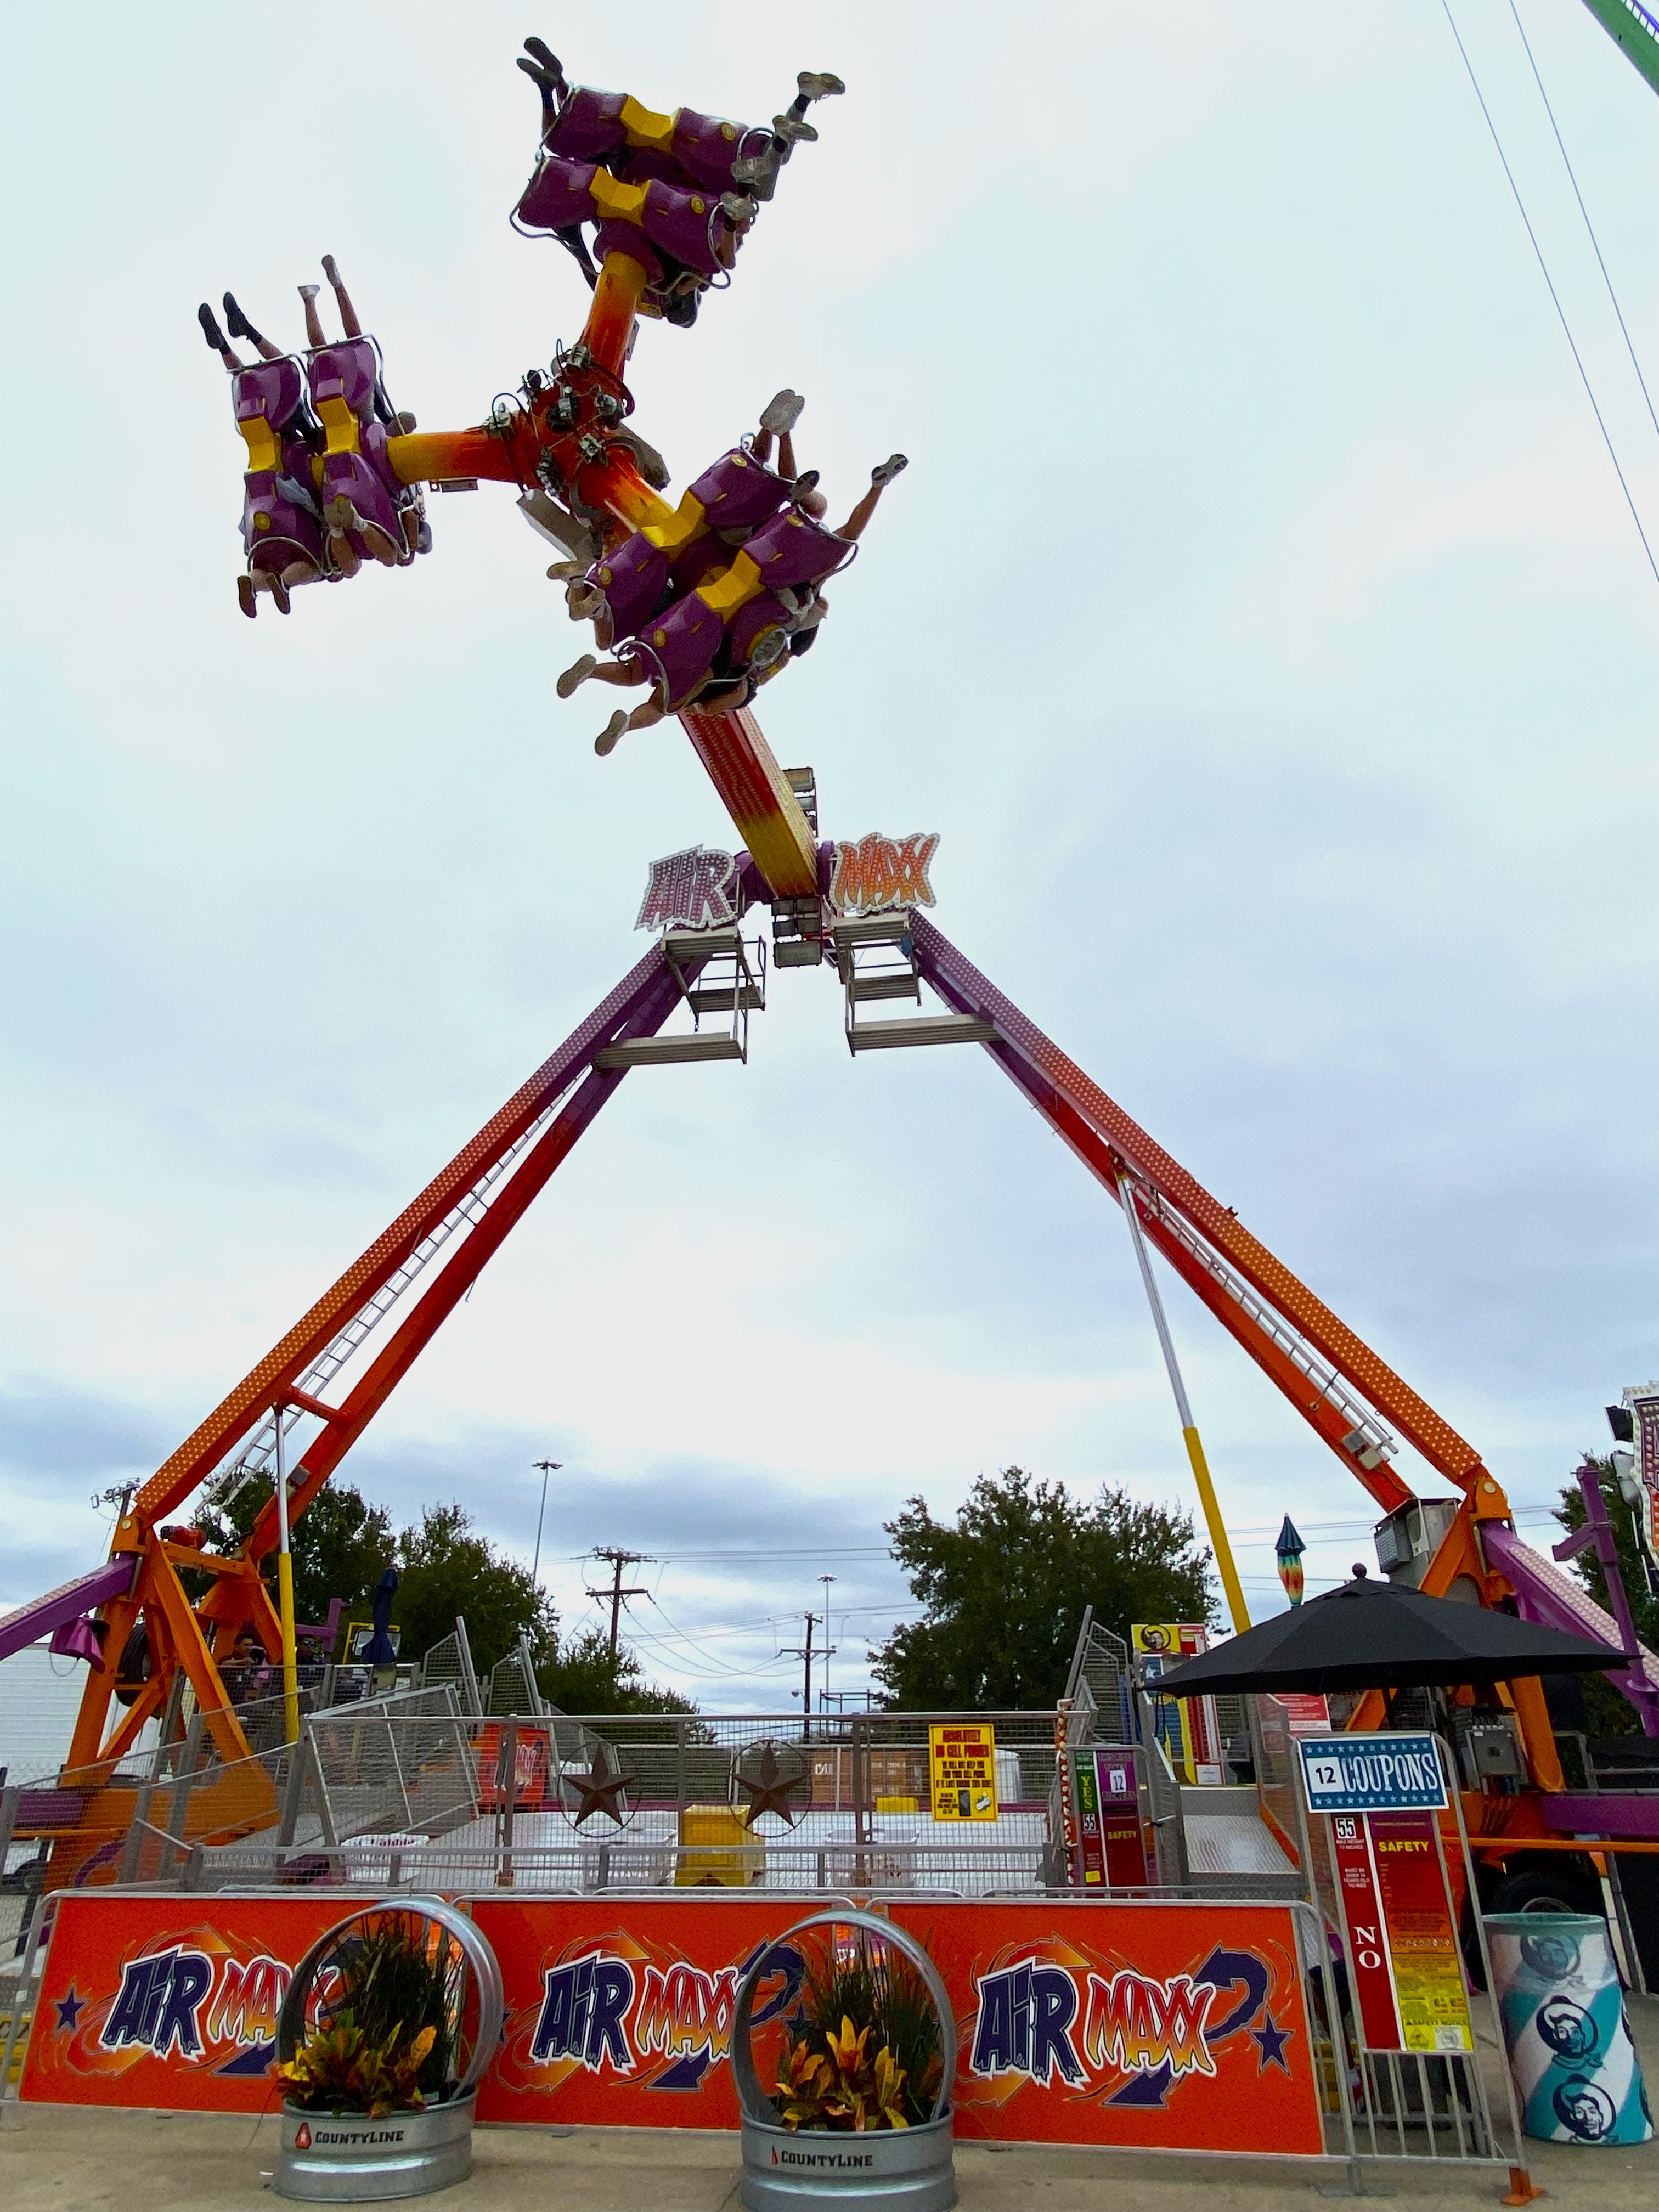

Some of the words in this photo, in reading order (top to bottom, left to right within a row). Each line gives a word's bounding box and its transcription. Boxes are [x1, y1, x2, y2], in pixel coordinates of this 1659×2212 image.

[833, 834, 938, 911] MAXX
[1113, 1775, 1124, 1791] 12
[1315, 1766, 1336, 1784] 12
[1342, 1753, 1439, 1792] COUPONS
[1080, 1776, 1093, 1809] YES
[1084, 1814, 1095, 1829] 55
[1336, 1818, 1355, 1837] 55
[1108, 1830, 1137, 1840] SAFETY
[1378, 1841, 1429, 1852] SAFETY
[1352, 1926, 1381, 1969] NO
[636, 1964, 740, 2058] MAXX
[1086, 1971, 1216, 2076] MAXX
